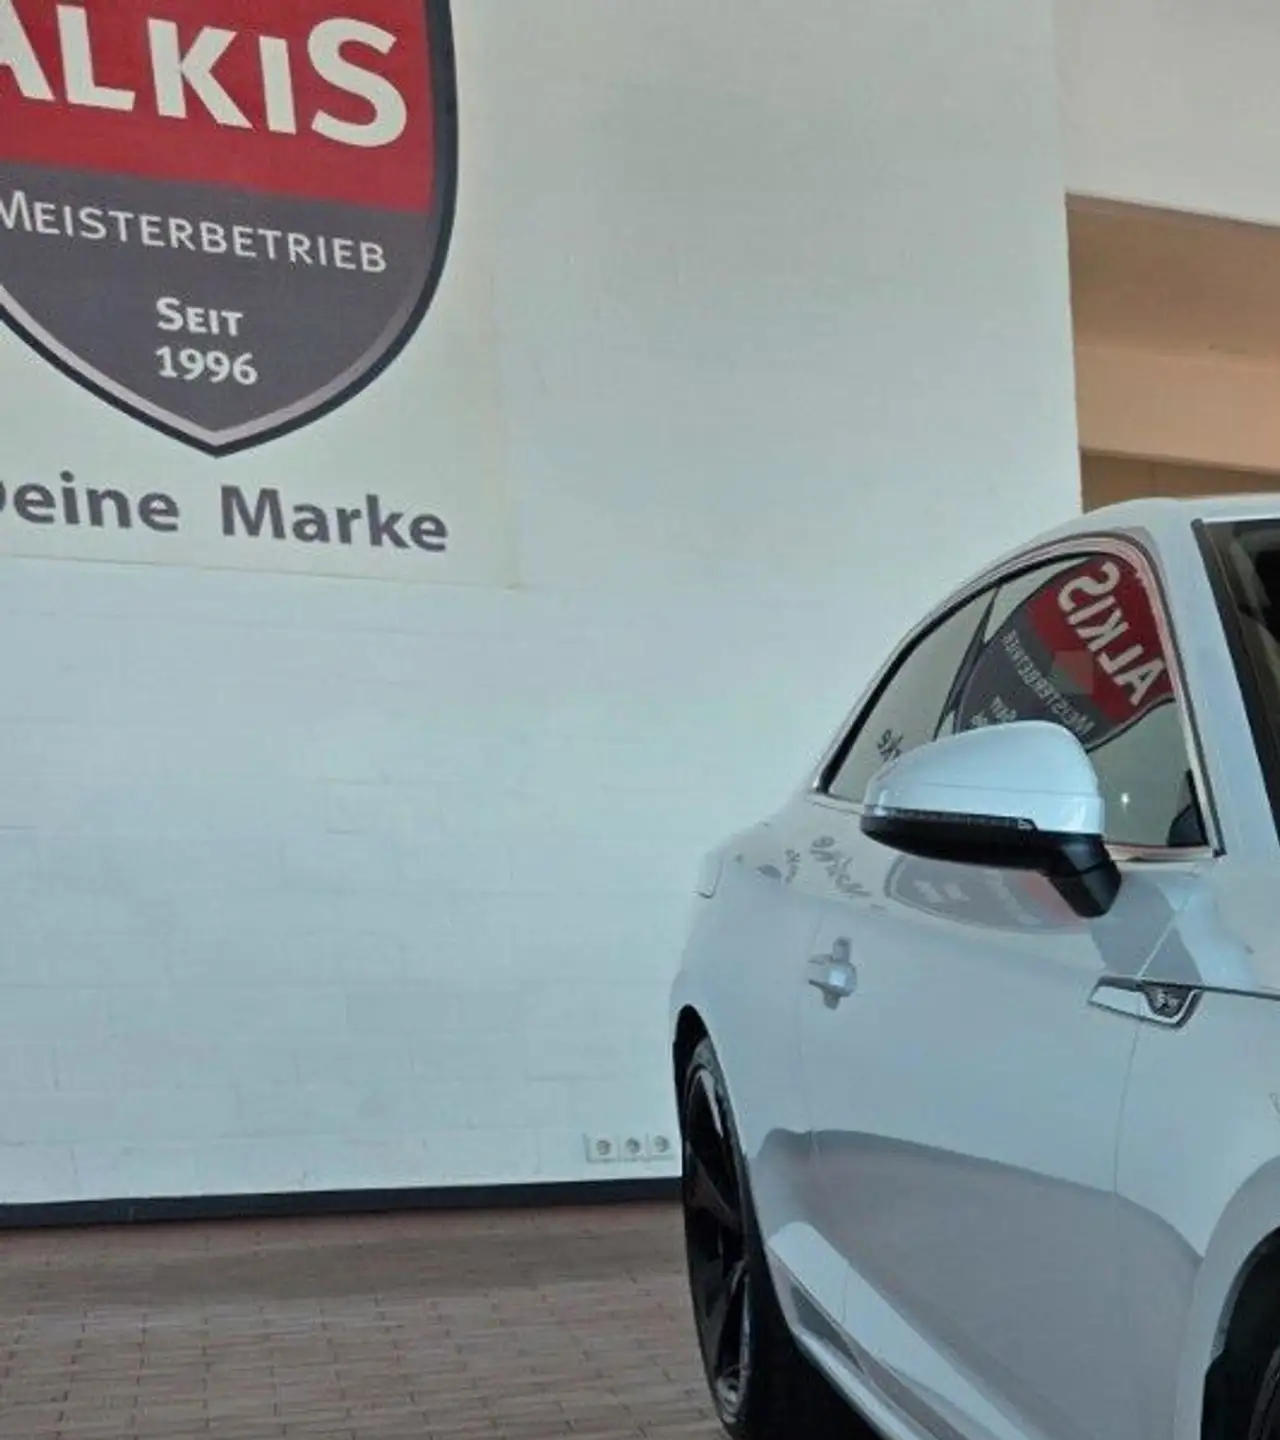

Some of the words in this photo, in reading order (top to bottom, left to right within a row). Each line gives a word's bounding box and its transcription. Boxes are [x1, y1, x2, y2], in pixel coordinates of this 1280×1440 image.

[0, 190, 387, 273] MEISTERBETRIEB
[154, 346, 258, 386] 1996
[0, 470, 180, 532] eine
[219, 485, 448, 552] Marke
